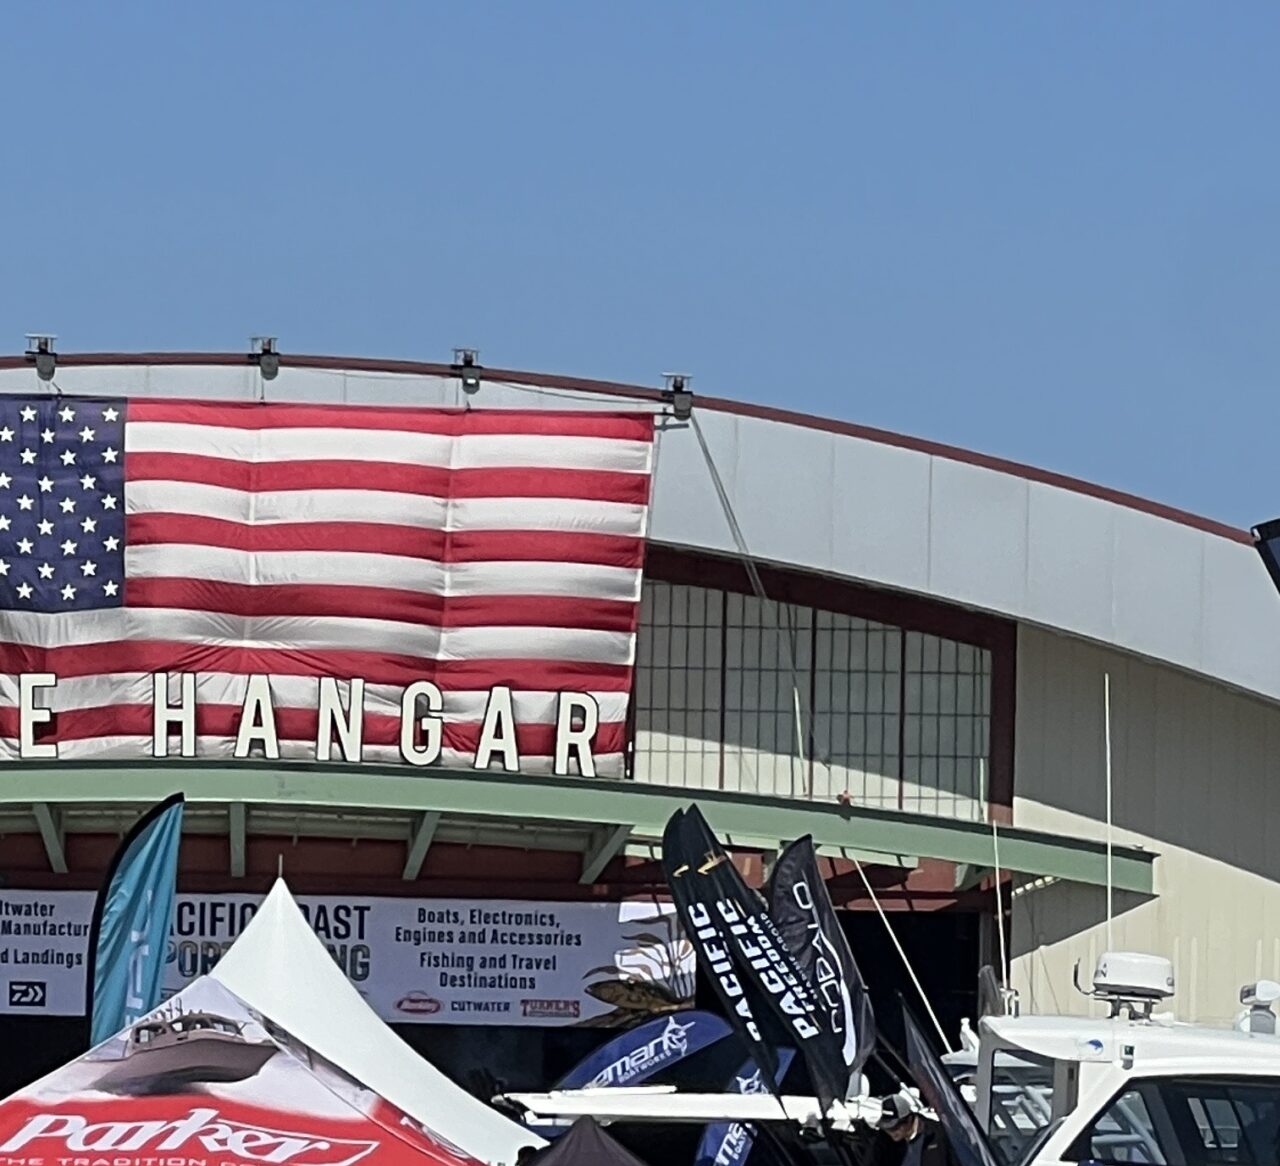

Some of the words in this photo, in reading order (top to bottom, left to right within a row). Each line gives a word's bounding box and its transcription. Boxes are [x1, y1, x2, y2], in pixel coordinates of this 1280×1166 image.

[152, 672, 598, 778] HANGAR
[417, 907, 465, 926] Boats,
[469, 909, 560, 928] Electronics,
[395, 926, 453, 946] Engines
[458, 929, 486, 943] and
[490, 929, 582, 946] Accessories
[14, 949, 82, 969] Landings
[420, 952, 474, 972] Fishing
[479, 954, 507, 969] and
[511, 954, 557, 971] Travel
[716, 898, 820, 1040] PACIFIC
[746, 915, 816, 1013] FREEDOM
[440, 972, 536, 989] Destinations
[451, 1000, 511, 1013] CUTWATER
[3, 1107, 340, 1164] Parker
[57, 1157, 207, 1166] TRADITION
